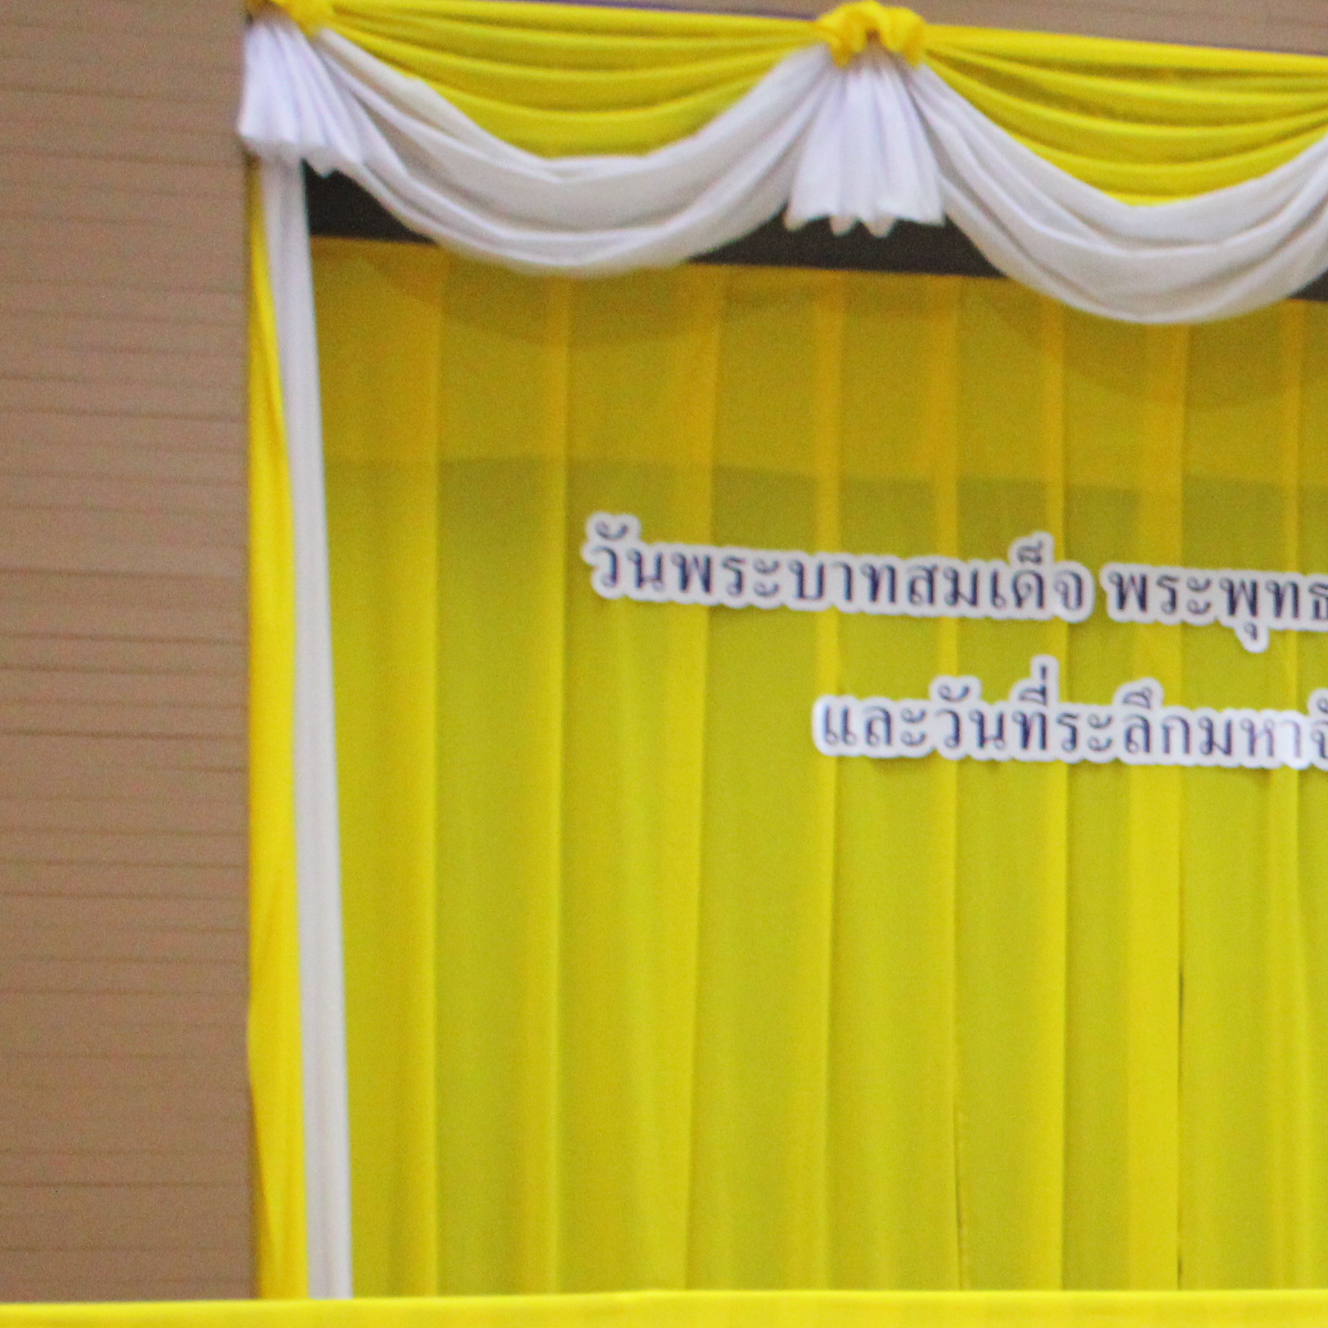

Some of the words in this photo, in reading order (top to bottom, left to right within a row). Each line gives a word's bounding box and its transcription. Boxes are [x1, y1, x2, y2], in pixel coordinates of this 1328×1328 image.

[594, 519, 1084, 613] วันพระบาทสมเด็จ
